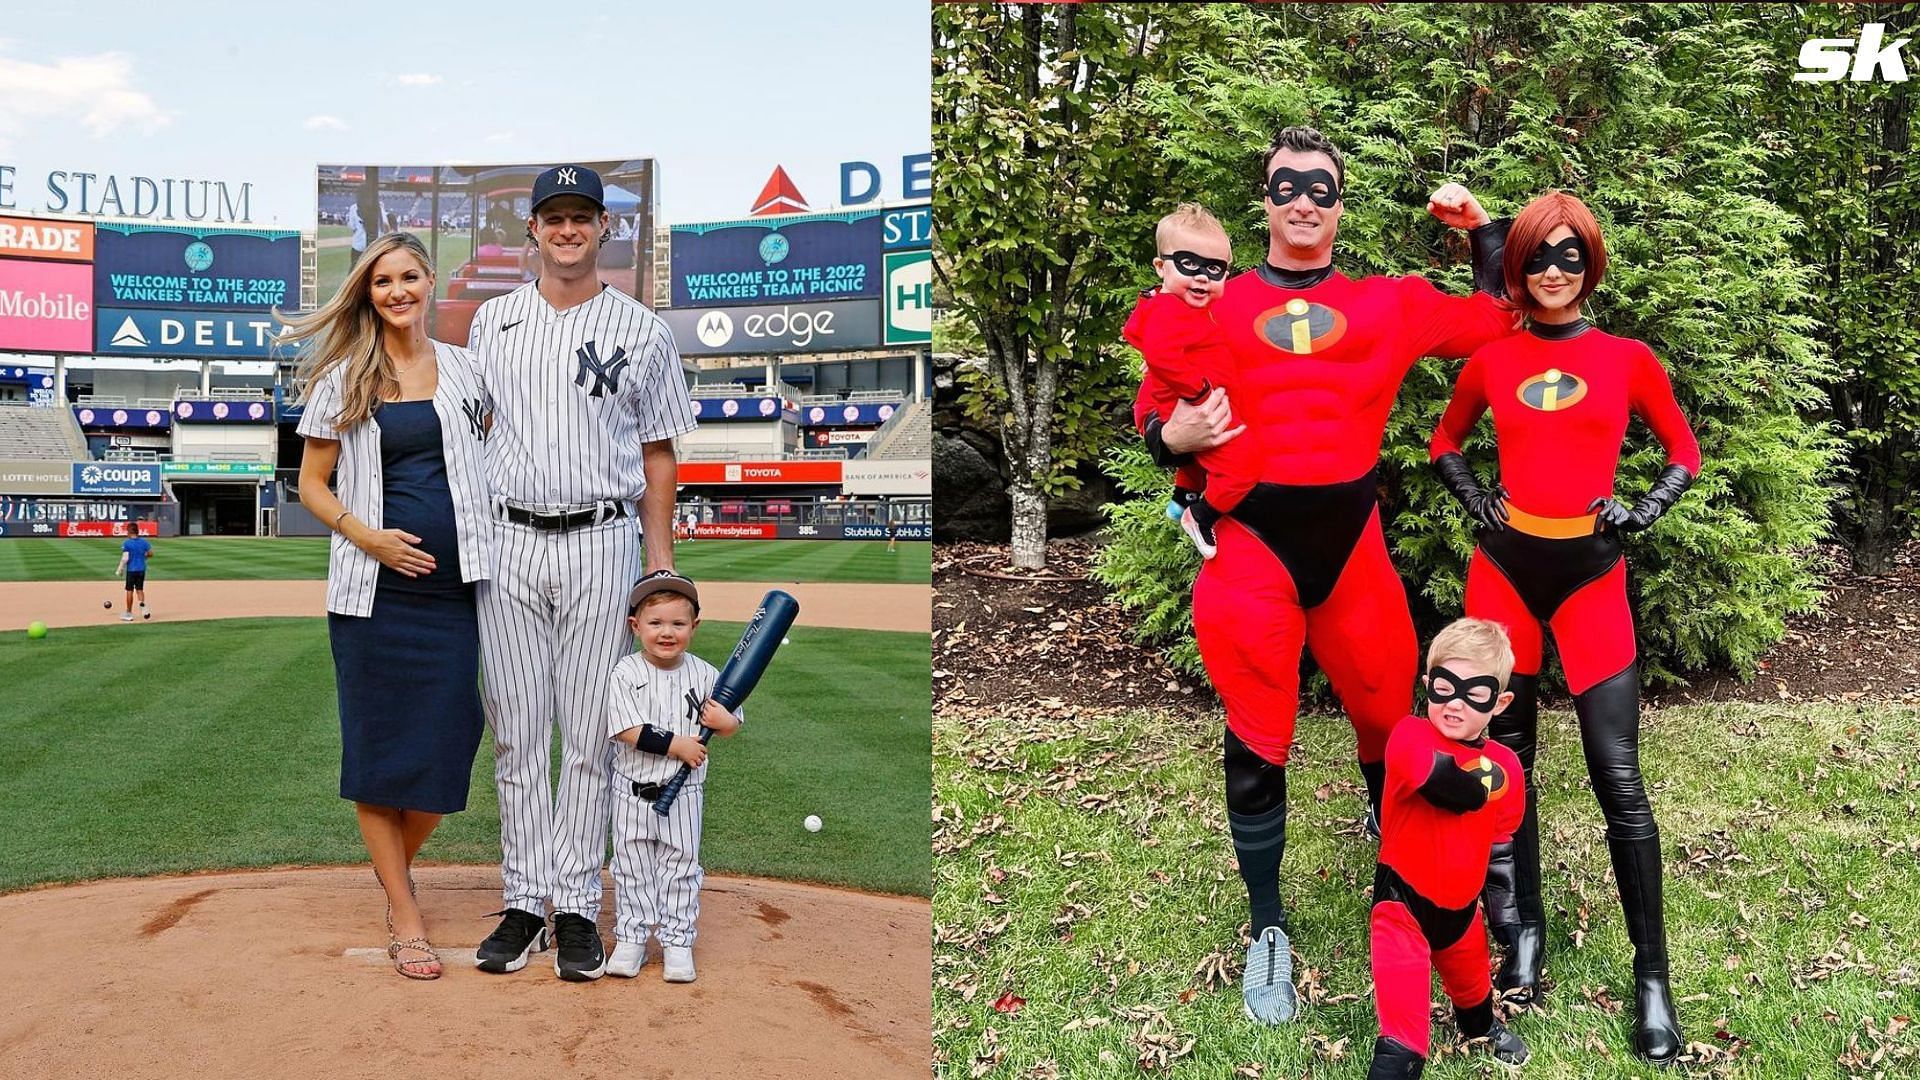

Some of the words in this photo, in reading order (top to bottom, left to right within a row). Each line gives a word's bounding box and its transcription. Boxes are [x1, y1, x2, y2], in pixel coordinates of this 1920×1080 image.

[557, 167, 577, 185] NY
[47, 170, 253, 223] STADIUM
[111, 274, 187, 290] WELCOME
[192, 278, 212, 290] TO
[216, 279, 244, 291] THE
[249, 279, 286, 292] 2022
[685, 272, 763, 287] WELCOME
[767, 270, 788, 283] TO
[792, 267, 821, 281] THE
[827, 264, 866, 279] 2022
[113, 287, 183, 302] YANKEES
[187, 290, 229, 303] TEAM
[233, 291, 284, 305] PICNIC
[688, 285, 757, 300] YANKEES
[763, 282, 805, 296] TEAM
[810, 278, 863, 293] PICNIC
[0, 289, 89, 321] Mobile
[744, 306, 835, 347] edge
[574, 340, 629, 398] NY
[3, 474, 34, 482] LOTTE
[36, 474, 69, 482] HOTELS
[103, 469, 151, 486] coupa
[744, 468, 782, 477] TOYOTA
[33, 524, 48, 533] 399
[844, 527, 882, 537] StubHub
